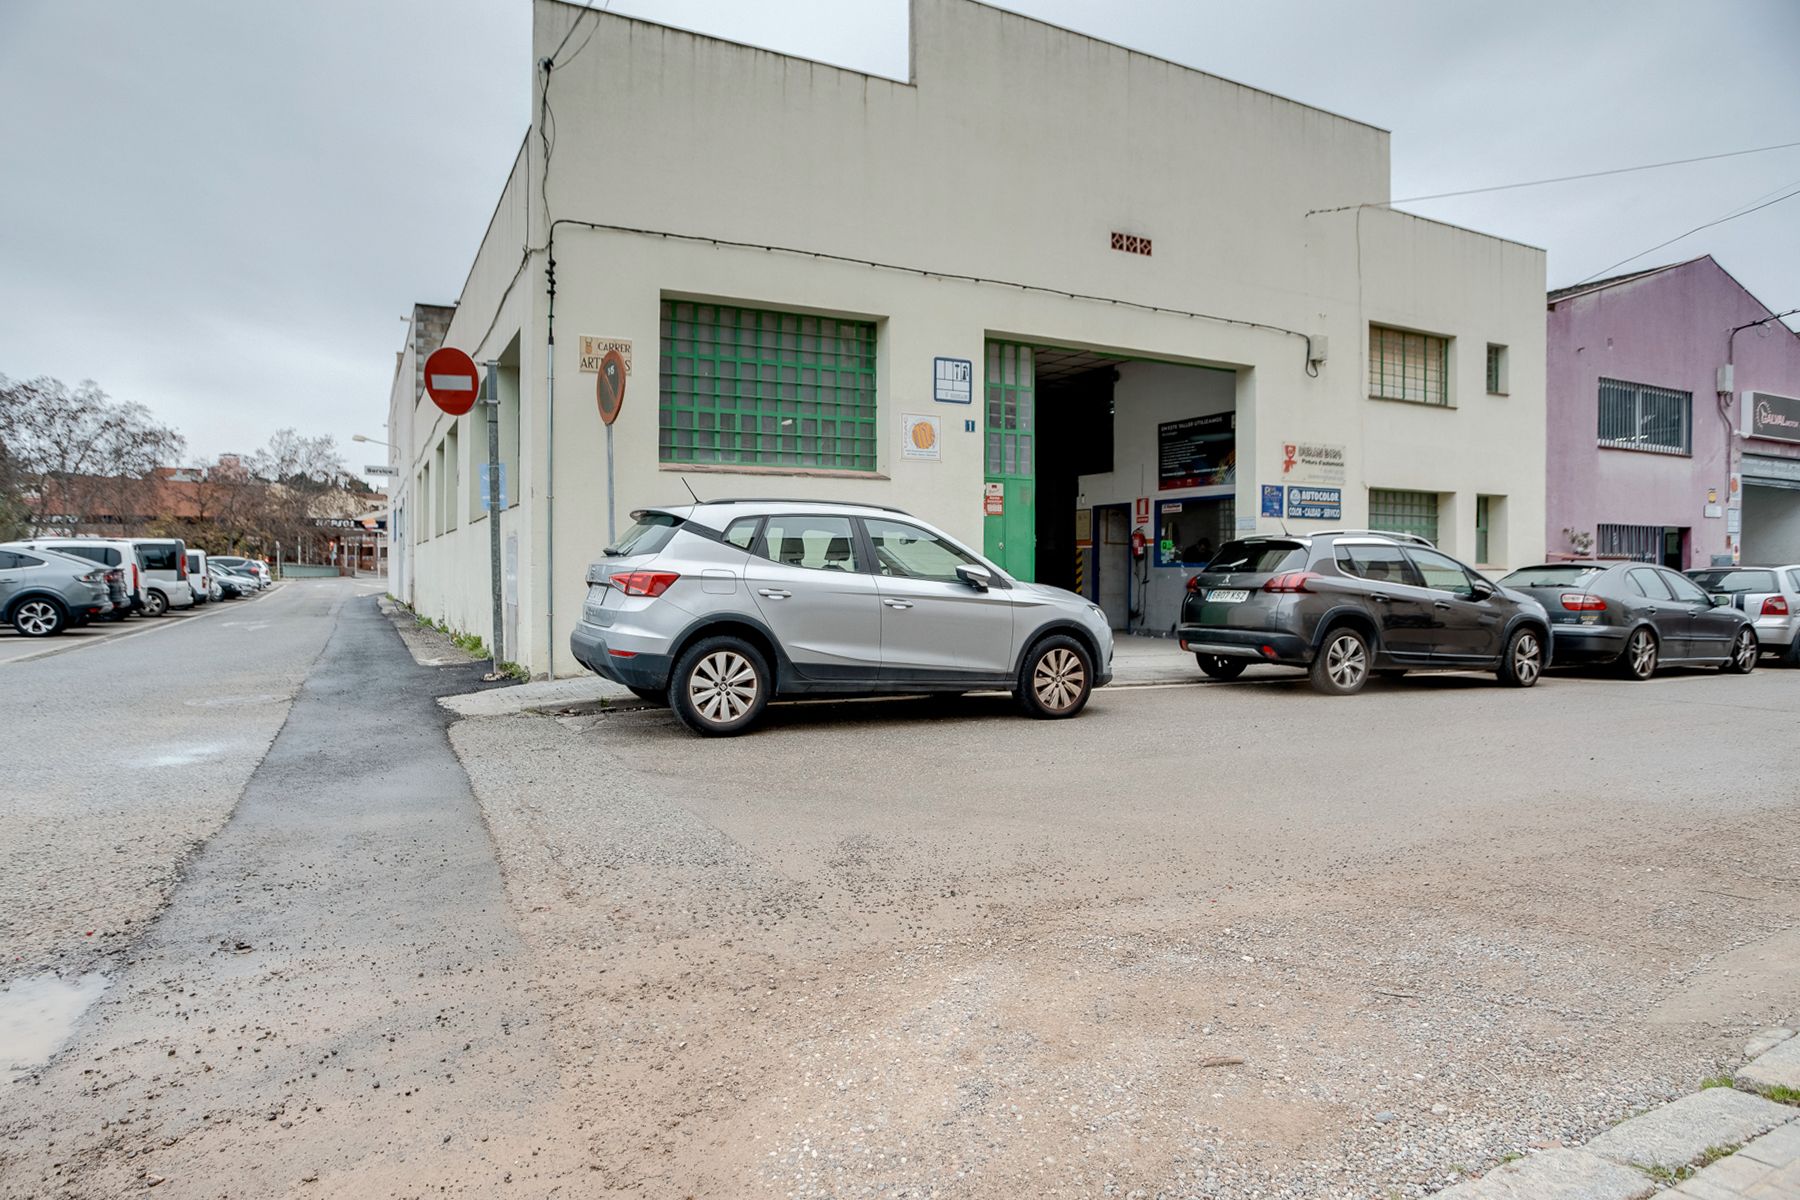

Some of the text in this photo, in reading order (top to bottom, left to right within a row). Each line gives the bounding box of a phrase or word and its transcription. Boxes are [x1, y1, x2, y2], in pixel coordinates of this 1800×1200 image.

[597, 342, 630, 353] CARRER
[580, 357, 631, 371] ARTS
[1301, 491, 1339, 501] AUTOCOLOR
